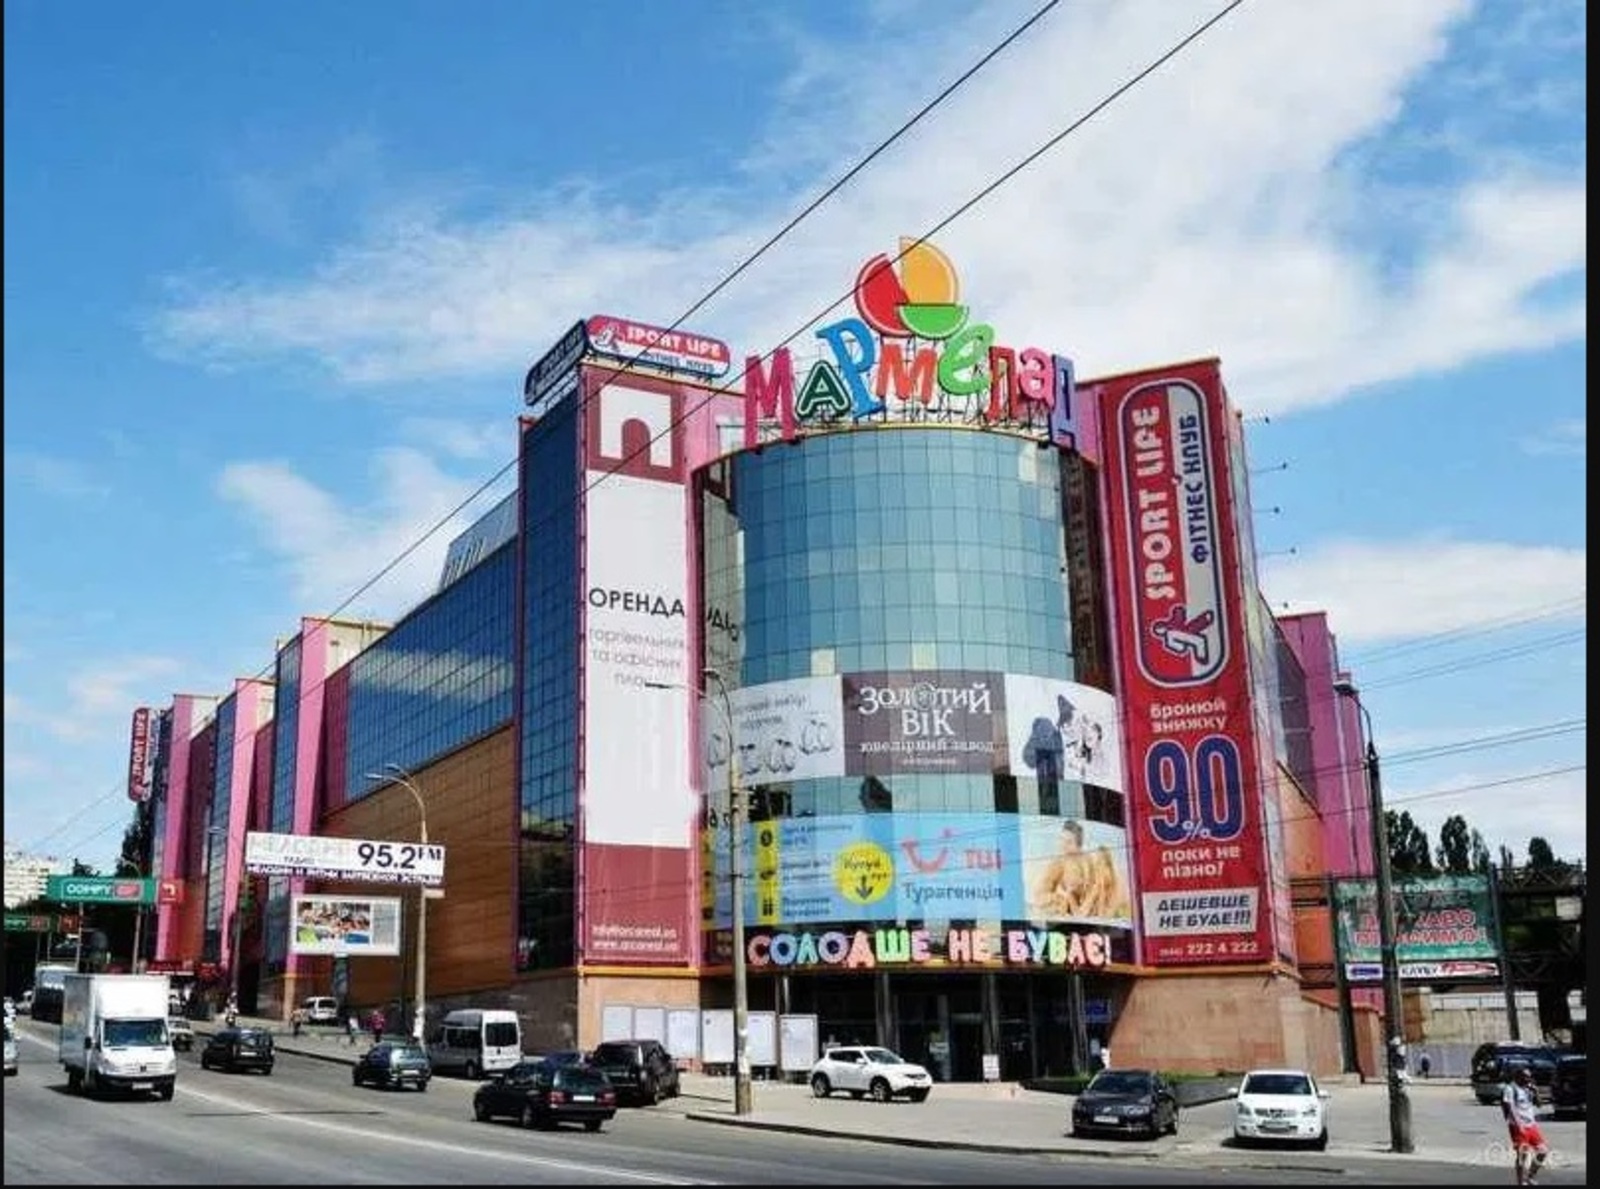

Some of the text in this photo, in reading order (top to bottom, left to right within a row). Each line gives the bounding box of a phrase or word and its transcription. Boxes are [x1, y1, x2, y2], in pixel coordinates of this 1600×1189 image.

[1178, 414, 1211, 563] ФІТНЕС КЛУБ
[1132, 405, 1176, 600] SPORT LIFE
[589, 587, 685, 618] ОРЕНДА
[1150, 698, 1226, 719] бронюй
[1152, 715, 1227, 734] знижку
[358, 842, 441, 869] 95.2 FM
[903, 881, 1004, 904] Турагенція
[1157, 895, 1250, 912] ДЕШЕВШЕ
[1159, 909, 1251, 928] НЕ БУДЕ!!!
[748, 928, 1112, 969] СОЛОДШЕ НЕ БУВАЄ!
[1187, 942, 1215, 955] 222
[1230, 940, 1258, 953] 222
